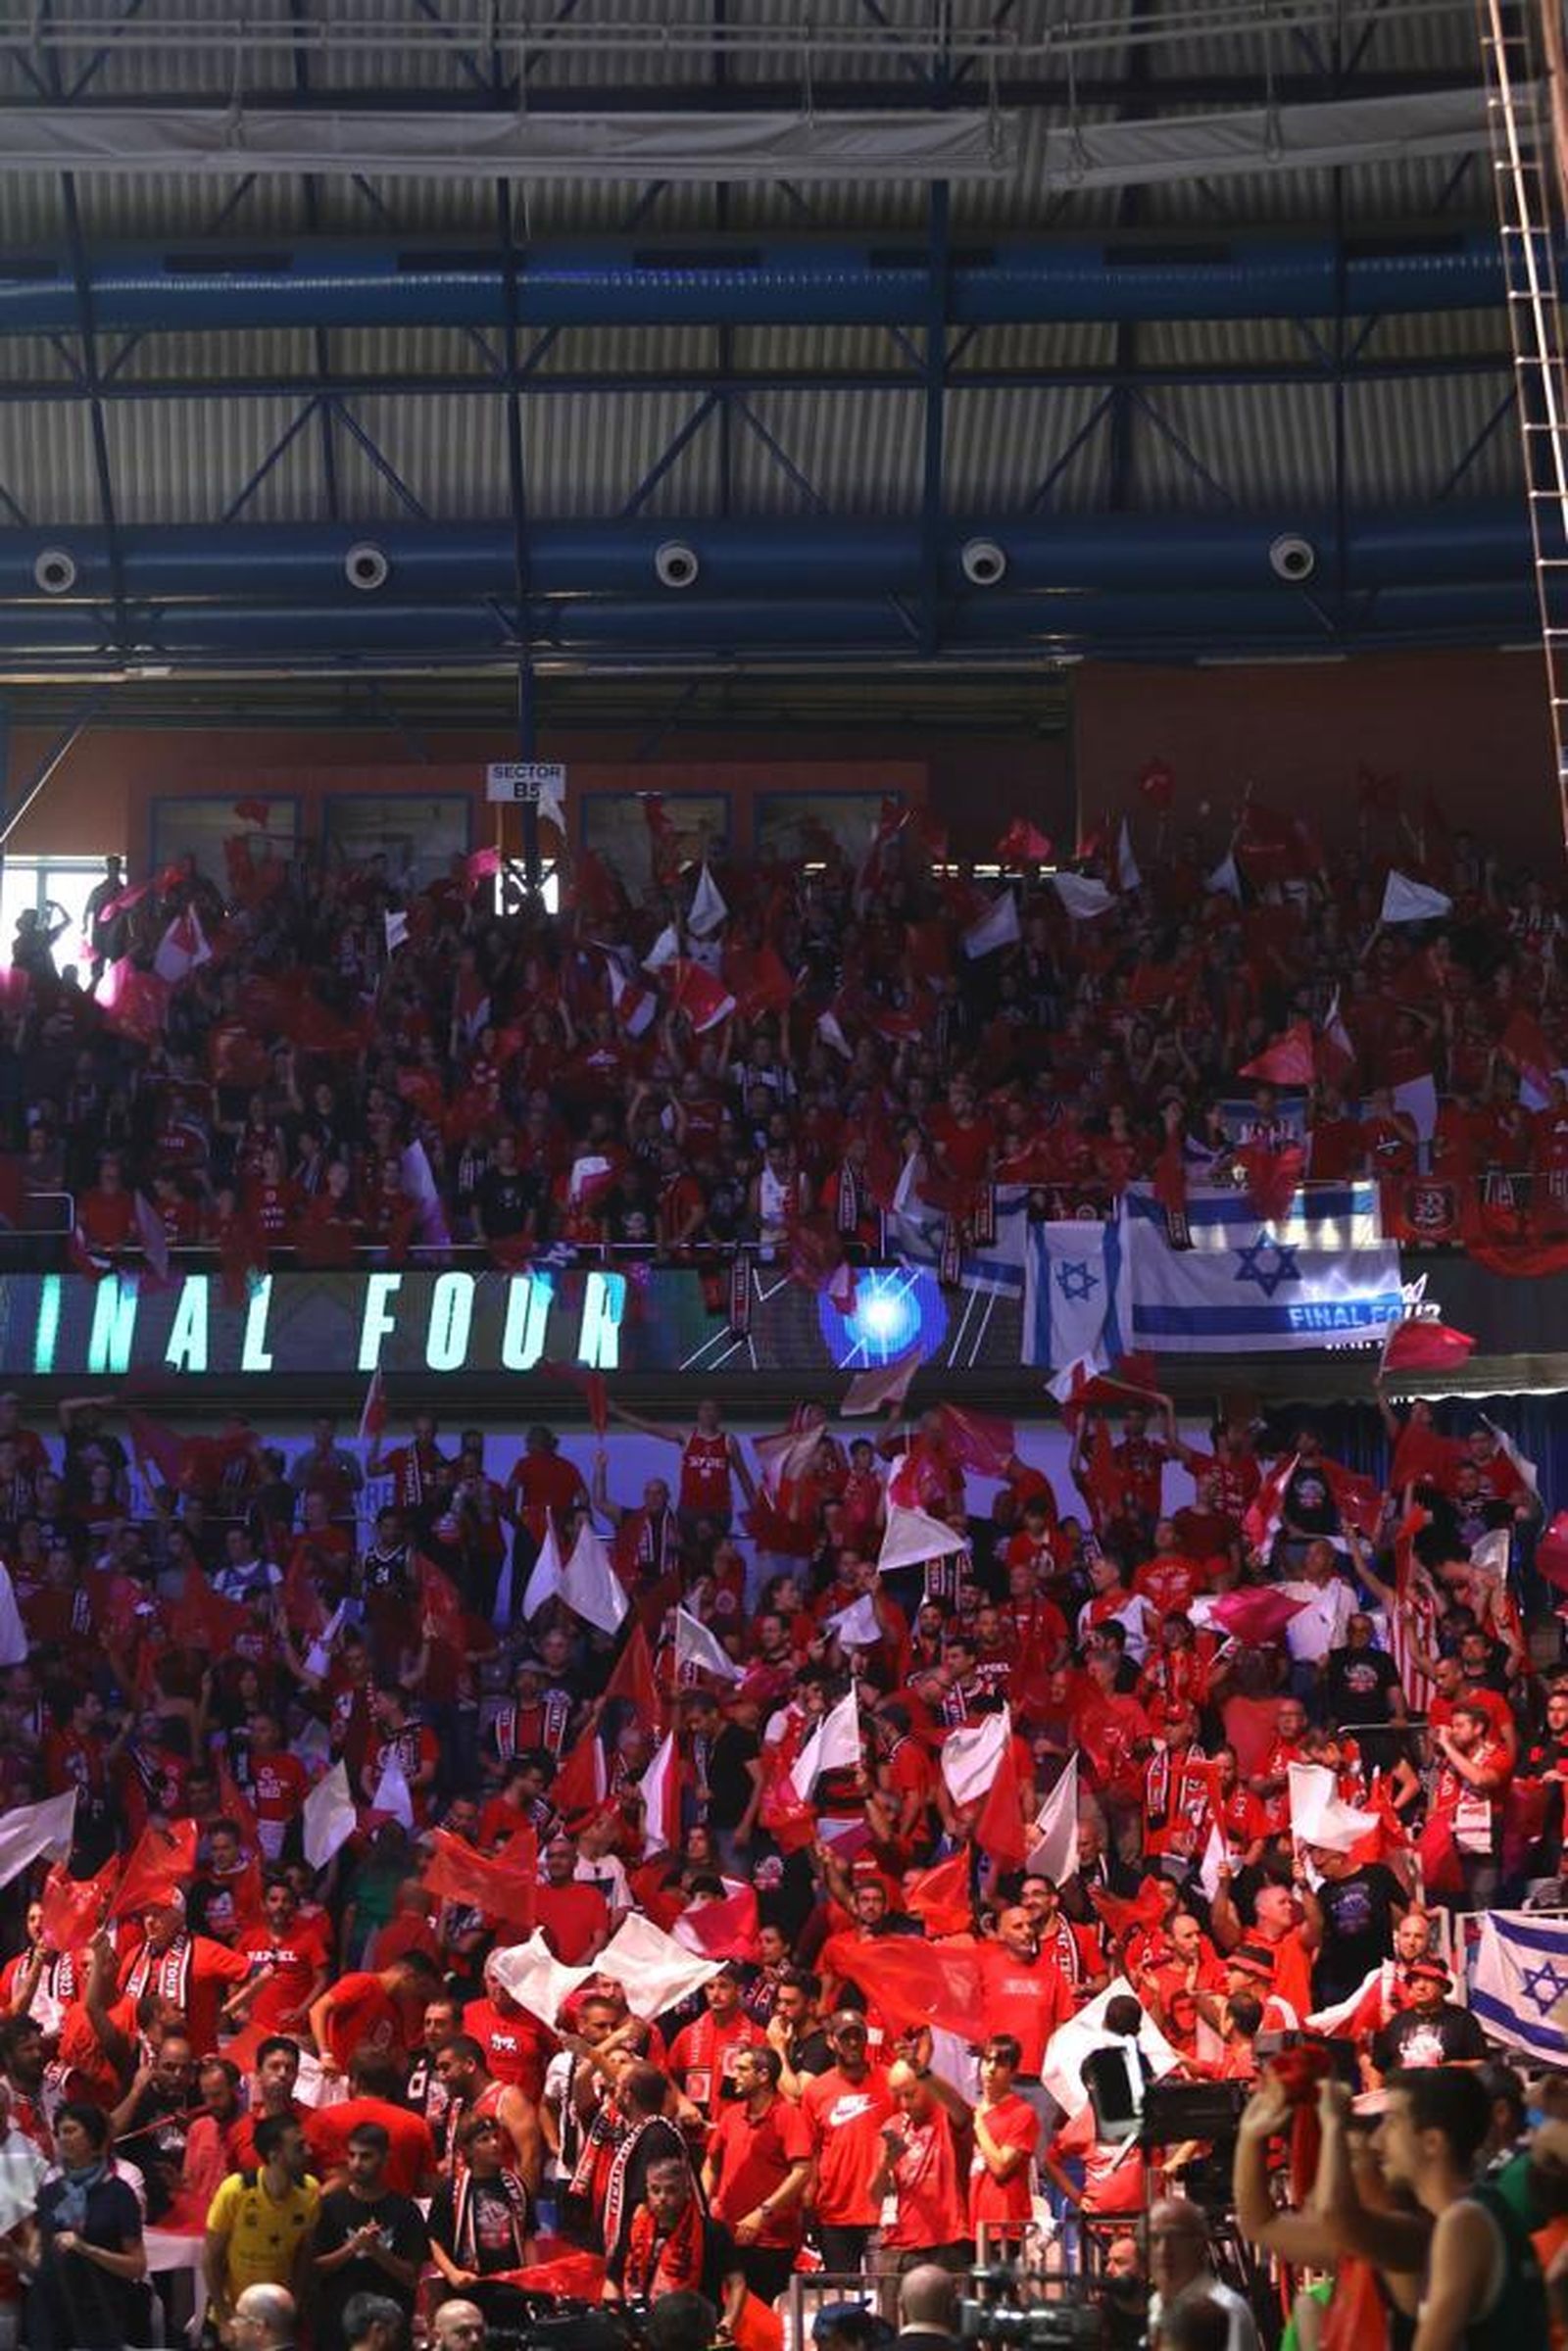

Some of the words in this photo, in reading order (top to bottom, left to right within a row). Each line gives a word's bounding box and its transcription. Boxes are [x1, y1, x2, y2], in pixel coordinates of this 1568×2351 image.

[493, 766, 561, 778] SECTOR
[514, 782, 541, 798] B5
[33, 1274, 272, 1373] INAL
[357, 1273, 626, 1371] FOUR
[1288, 1305, 1366, 1329] FINAL
